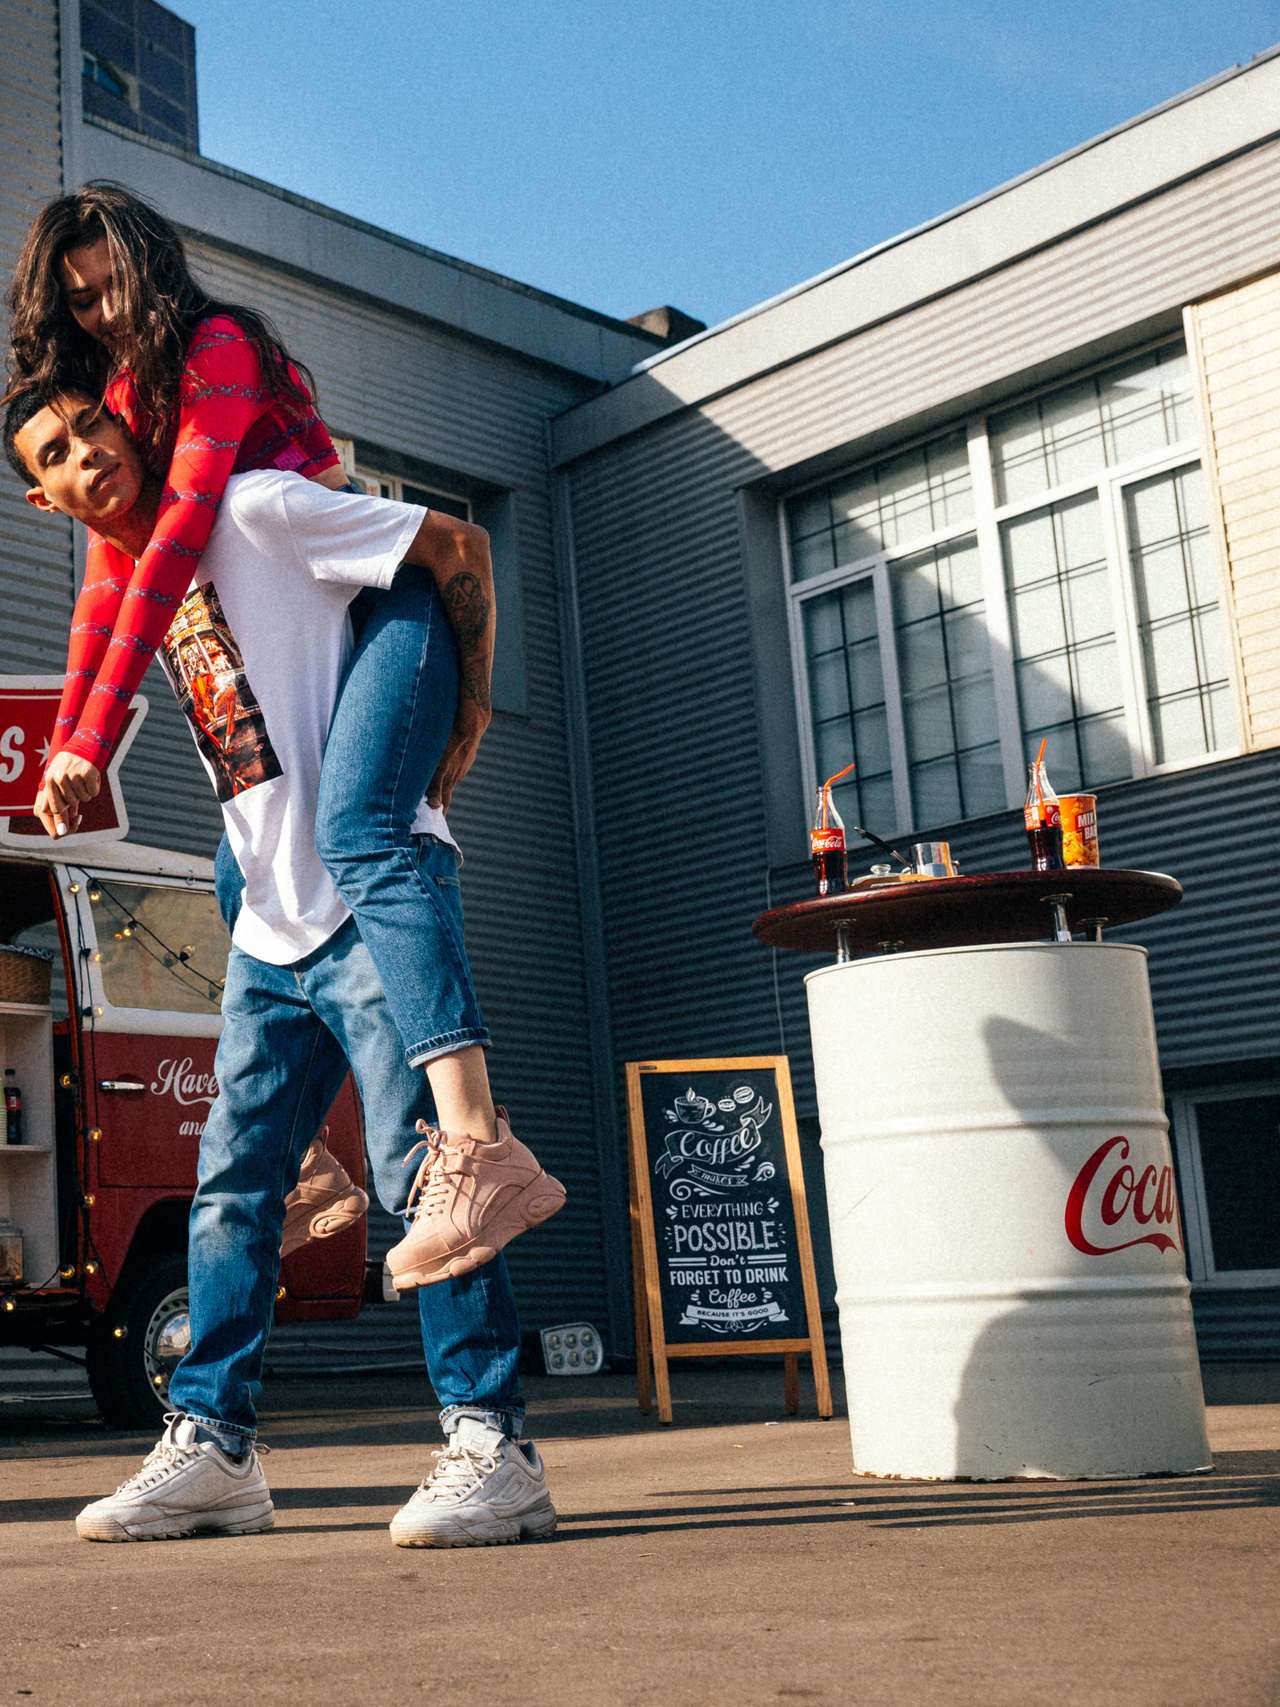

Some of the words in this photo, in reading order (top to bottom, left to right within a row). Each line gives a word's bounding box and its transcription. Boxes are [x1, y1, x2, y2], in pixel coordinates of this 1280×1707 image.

[1077, 811, 1094, 828] MIX
[150, 1057, 218, 1106] Have
[680, 1127, 754, 1166] Coffee
[701, 1172, 732, 1186] makes
[1065, 1136, 1184, 1256] Coca
[681, 1202, 764, 1218] EVERYTHING
[673, 1220, 779, 1253] POSSIBLE
[709, 1254, 746, 1267] Don't
[670, 1270, 720, 1286] FORGET
[724, 1269, 742, 1285] TO
[745, 1266, 789, 1284] DRINK
[708, 1288, 758, 1308] Coffee
[697, 1309, 730, 1318] BECAUSE
[747, 1307, 769, 1316] GOOD
